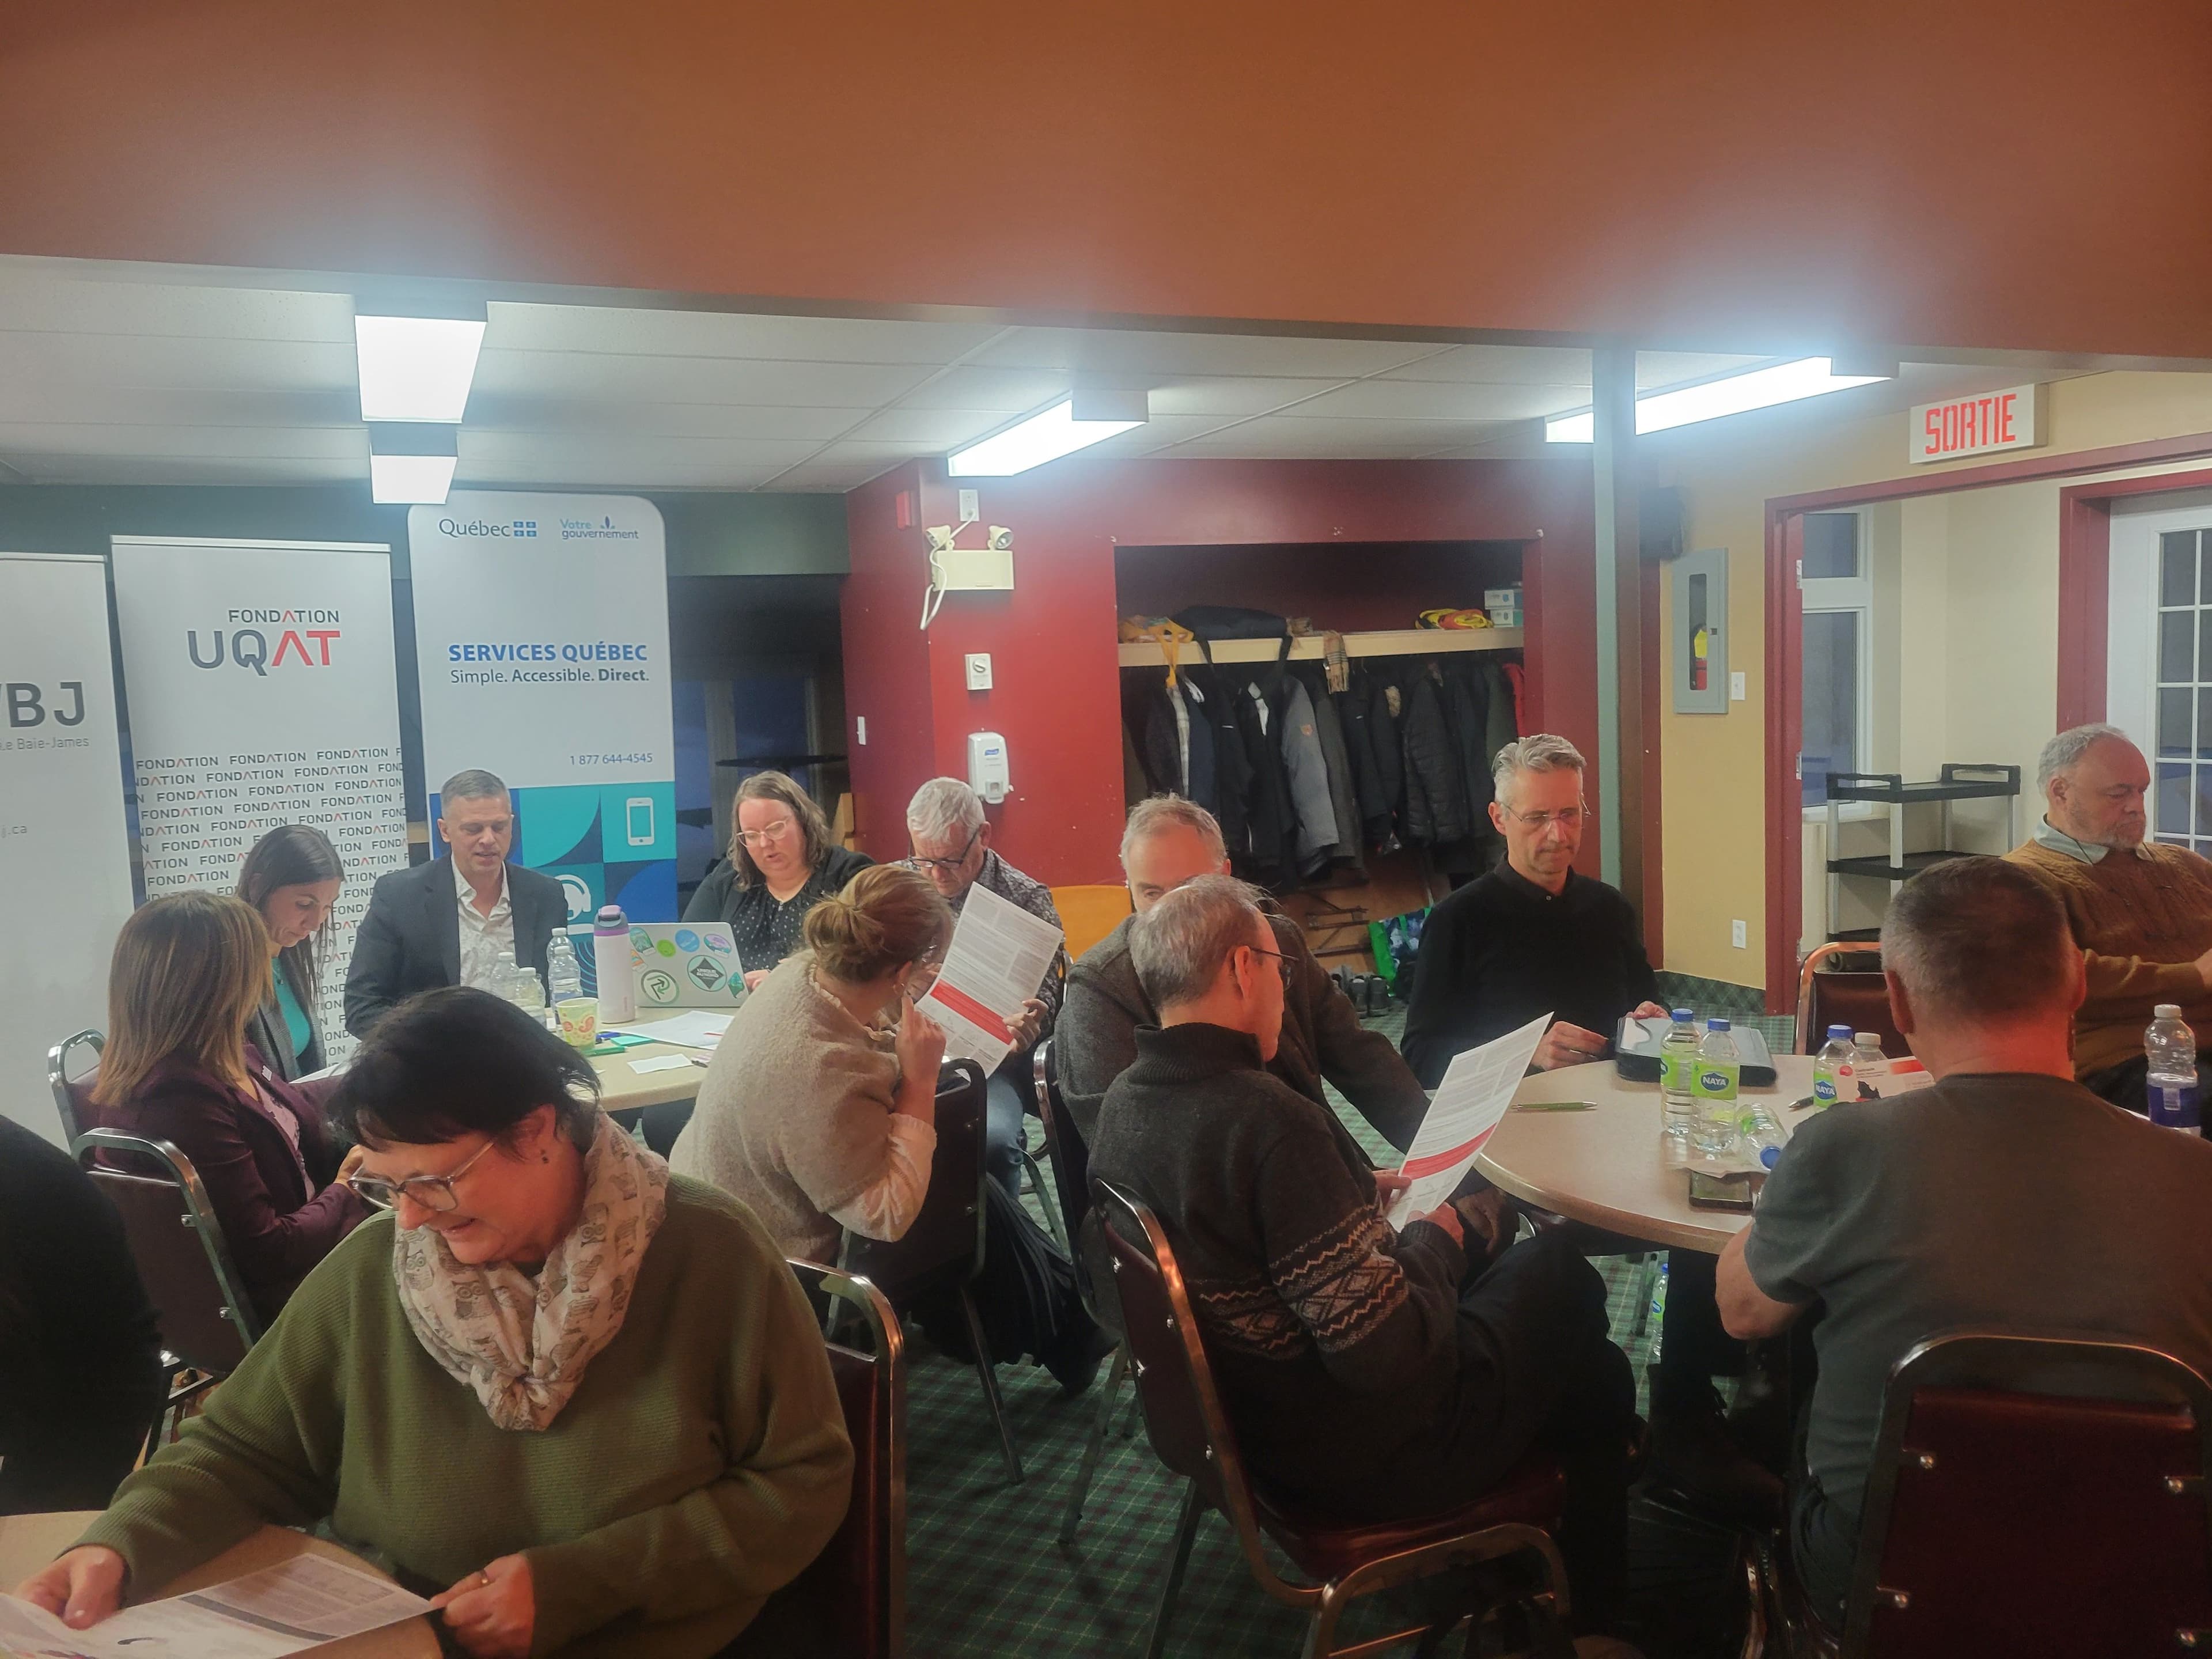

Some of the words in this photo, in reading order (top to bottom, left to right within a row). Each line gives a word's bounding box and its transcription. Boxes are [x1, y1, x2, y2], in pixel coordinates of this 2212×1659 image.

[1925, 393, 2017, 454] SORTIE
[438, 518, 511, 538] Québec
[559, 518, 592, 529] Votre
[562, 529, 639, 540] gouvernement
[228, 609, 340, 623] FONDATION
[187, 629, 340, 676] UQAT
[449, 645, 556, 661] SERVICES
[562, 641, 647, 662] QUÉBEC
[451, 669, 507, 685] Simple.
[512, 668, 594, 682] Accessible.
[599, 668, 649, 681] Direct.
[0, 681, 85, 728] BJ
[17, 737, 89, 750] Baie-James
[136, 756, 219, 770] FONDATION
[230, 752, 306, 764] FONDATION
[317, 748, 388, 760] FONDATION
[570, 755, 575, 765] 1
[579, 755, 599, 764] 877
[603, 753, 653, 764] 644-4545
[206, 770, 283, 782] FONDATION
[294, 764, 368, 777] FONDATION
[157, 788, 237, 802] FONDATION
[249, 783, 324, 796] FONDATION
[335, 778, 402, 790] FONDATION
[141, 805, 223, 820] FONDATION
[234, 800, 310, 813] FONDATION
[321, 794, 392, 806] FONDATION
[211, 817, 287, 831] FONDATION
[298, 810, 372, 825] FONDATION
[161, 836, 242, 852] FONDATION
[339, 823, 405, 836] FONDATION
[147, 870, 229, 887] FONDATION
[1702, 1076, 1726, 1086] NAYA
